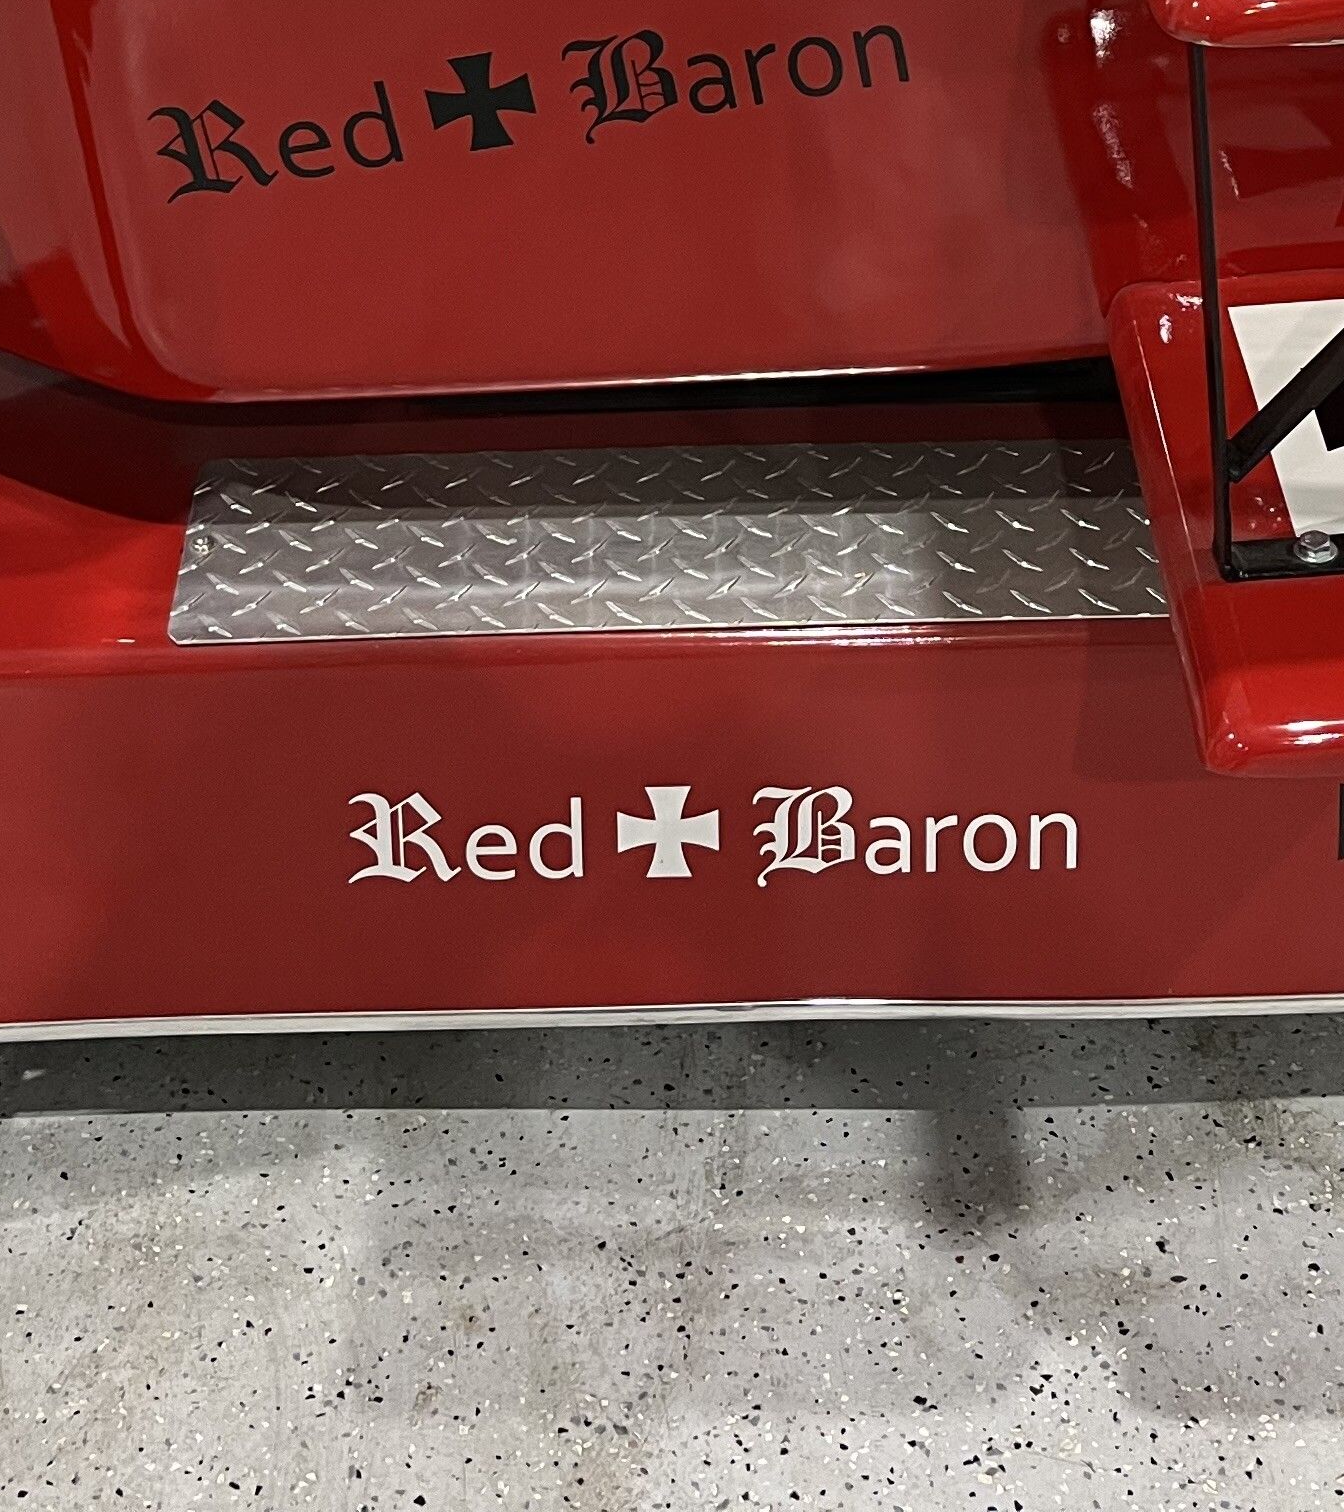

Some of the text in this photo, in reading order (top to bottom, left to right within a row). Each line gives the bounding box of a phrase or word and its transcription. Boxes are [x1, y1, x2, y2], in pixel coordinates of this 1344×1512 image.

[147, 24, 910, 204] Red Baron
[348, 786, 1078, 888] Red Baron
